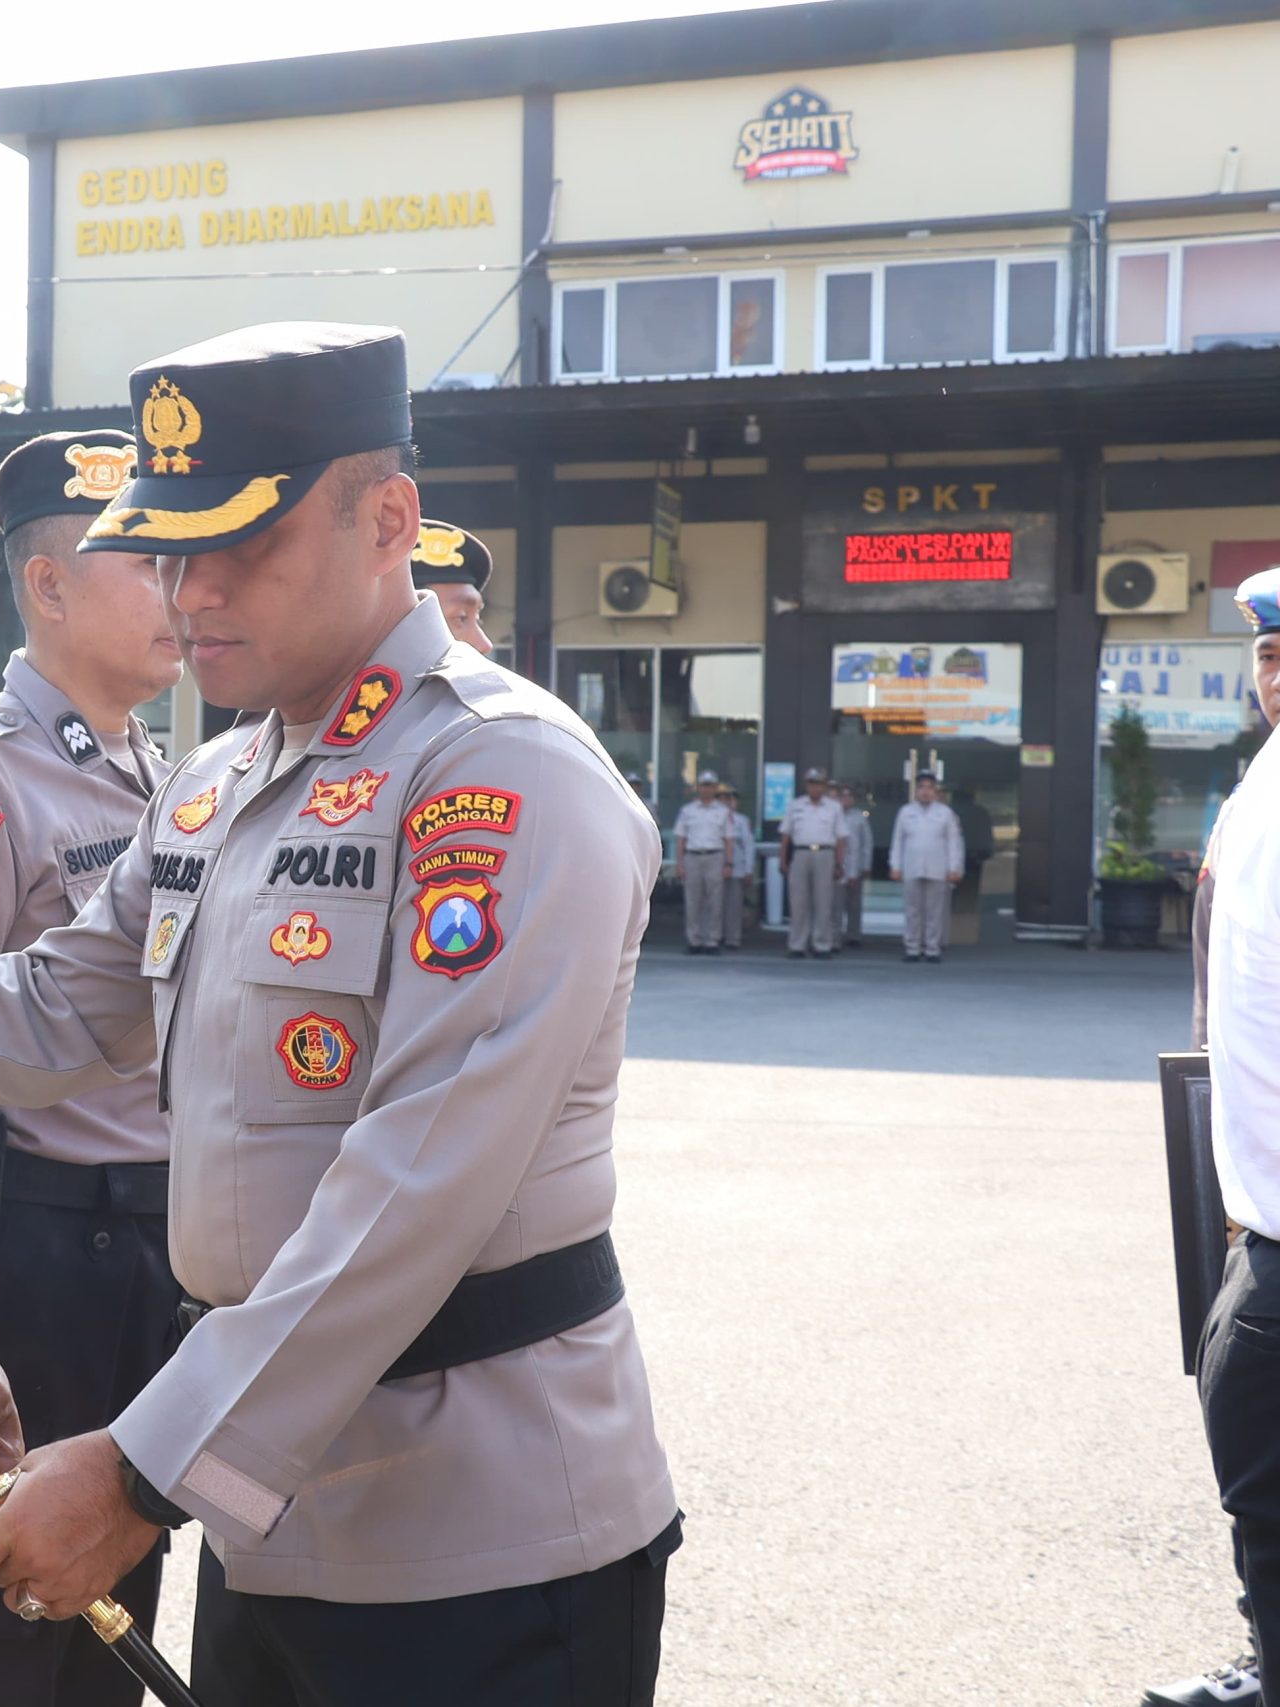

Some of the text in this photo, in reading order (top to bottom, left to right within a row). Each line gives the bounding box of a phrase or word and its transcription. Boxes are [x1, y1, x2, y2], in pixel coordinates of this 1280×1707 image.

[78, 161, 228, 207] GEDUNG
[76, 189, 495, 257] ENDRA DHARMALAKSANA
[863, 483, 997, 513] SPKT
[952, 533, 989, 547] DAN
[411, 793, 508, 832] POLRES
[418, 811, 505, 839] LAMONGAN
[268, 845, 376, 890] POLRI
[419, 851, 496, 874] JAWA TIMUR
